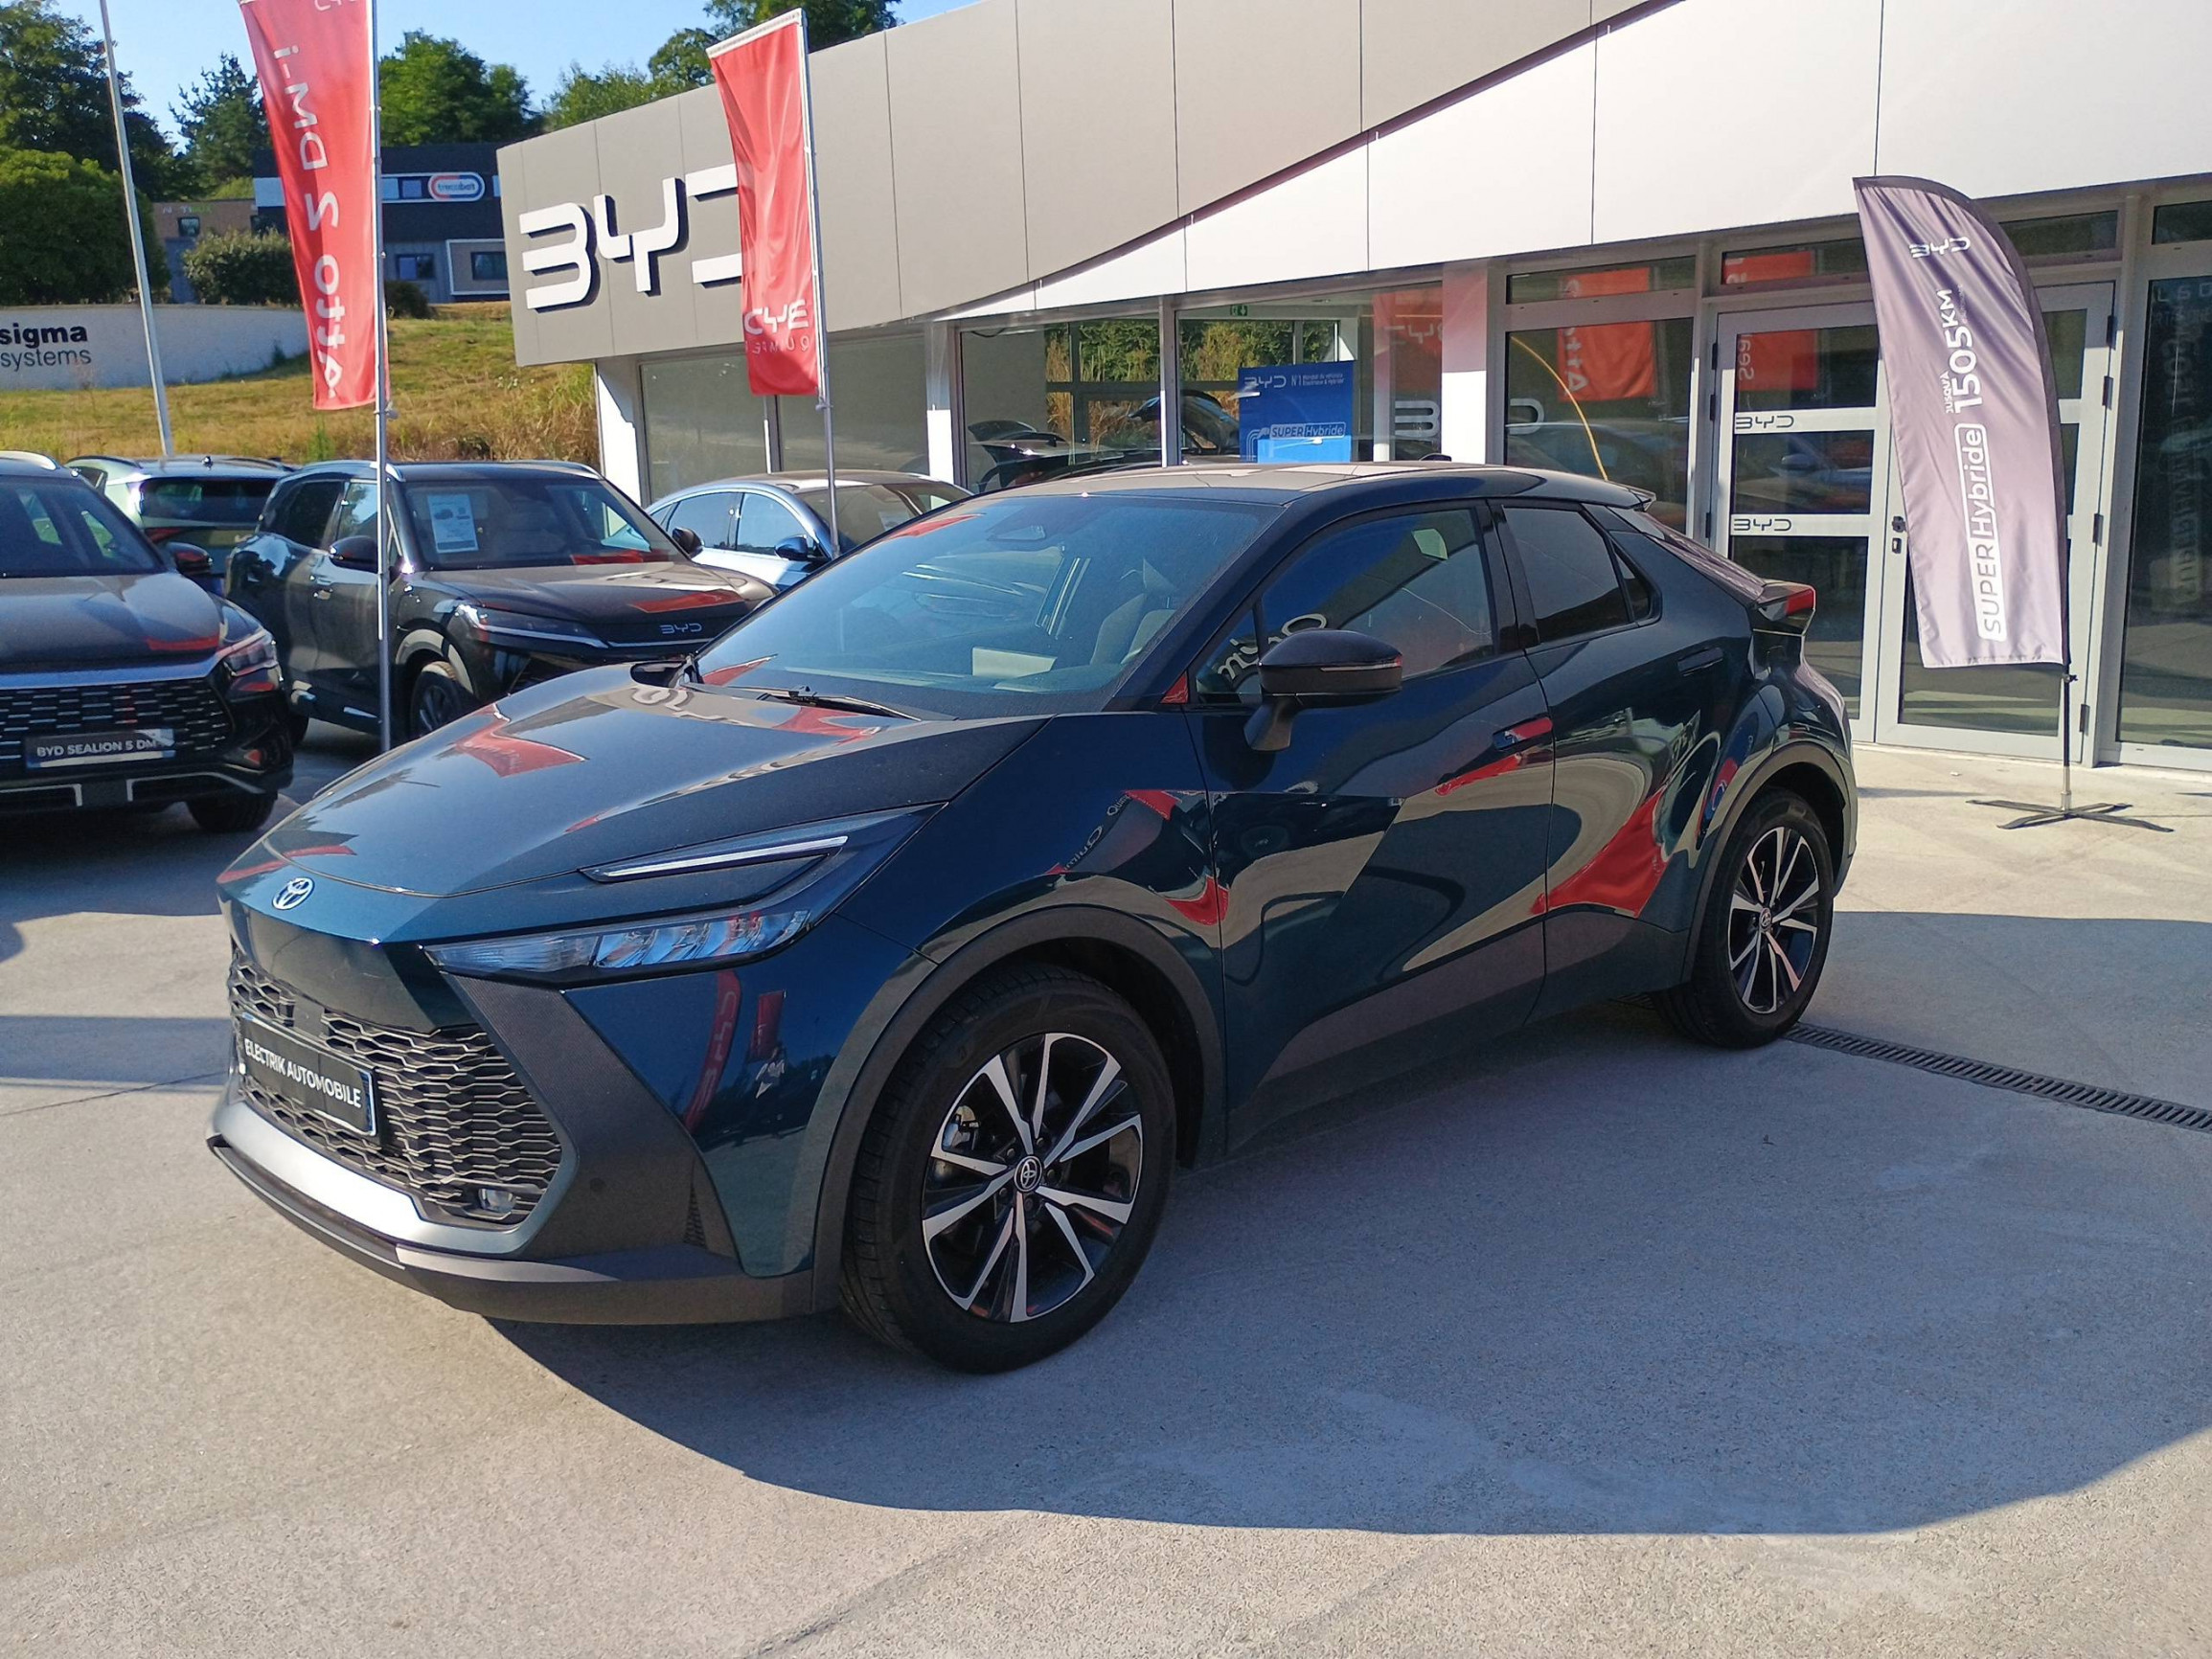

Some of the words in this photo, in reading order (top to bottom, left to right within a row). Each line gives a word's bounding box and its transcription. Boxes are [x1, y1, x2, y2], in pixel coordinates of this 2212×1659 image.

[0, 323, 88, 349] sigma
[0, 349, 92, 372] systems
[1271, 426, 1304, 438] SUPER
[1734, 415, 1794, 430] BYD
[1961, 429, 1995, 536] Hybride
[1732, 518, 1792, 532] BYD
[1975, 544, 2002, 634] SUPER
[659, 623, 702, 634] BYD
[36, 745, 64, 758] BYD
[67, 740, 123, 756] SEALION
[125, 739, 134, 751] 5
[244, 1037, 286, 1076] ELECTRIK
[286, 1060, 362, 1108] AUTOMOBILE
